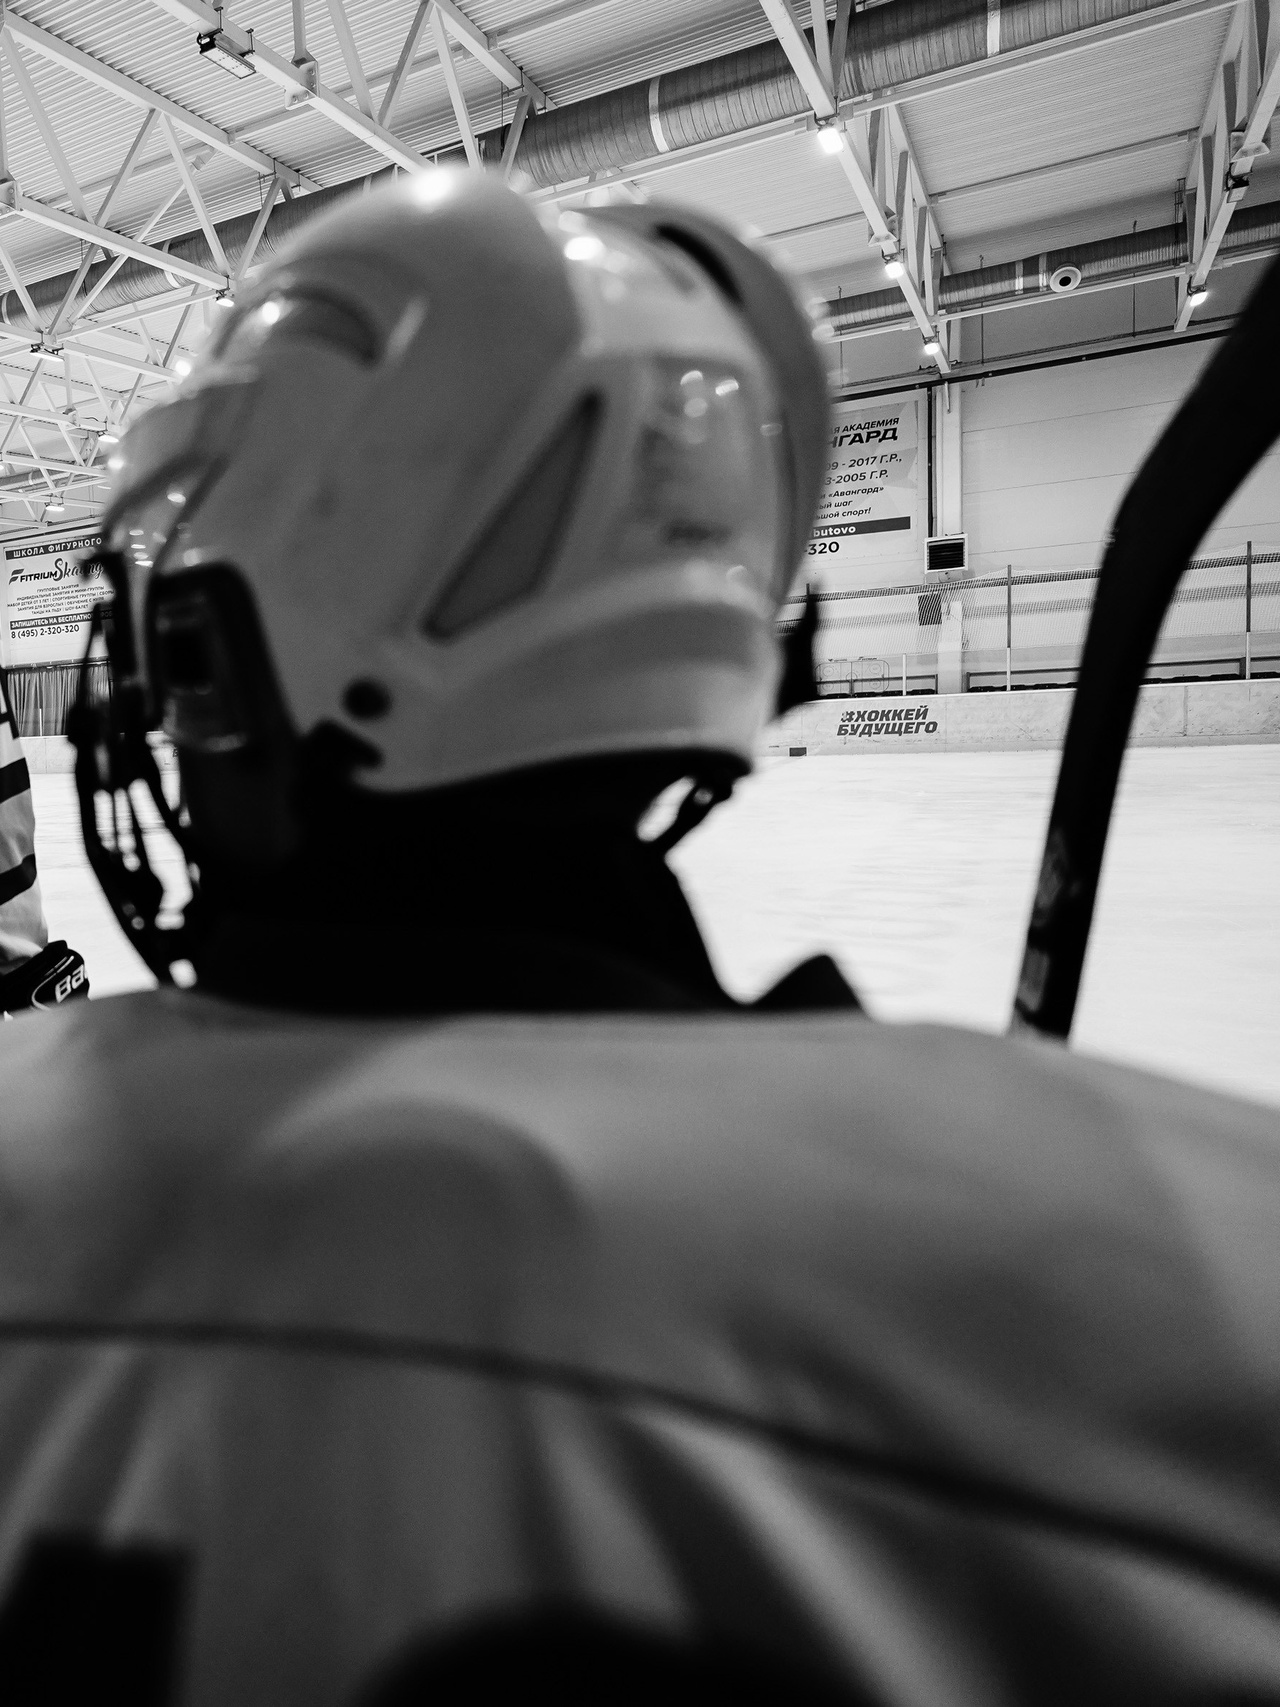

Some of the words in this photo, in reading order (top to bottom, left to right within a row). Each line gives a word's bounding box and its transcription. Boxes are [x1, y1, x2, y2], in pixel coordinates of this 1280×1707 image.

[842, 417, 900, 433] АКАДЕМИЯ
[848, 456, 877, 468] 2017
[834, 500, 853, 508] шаг
[842, 507, 871, 517] спорт!
[813, 525, 856, 538] butovo
[13, 547, 44, 558] ШКОЛА
[48, 537, 102, 552] ФИГУРНОГО
[20, 570, 58, 582] FITRIUM
[11, 619, 49, 628] ЗАПИШИТЕСЬ
[58, 612, 92, 623] БЕСПЛАТНО
[11, 631, 16, 639] 8
[18, 629, 38, 639] (495)
[40, 624, 80, 636] 2-320-320
[840, 705, 929, 723] #ХОККЕЙ
[837, 721, 938, 737] БУДУЩЕГО
[55, 964, 85, 1003] Ba
